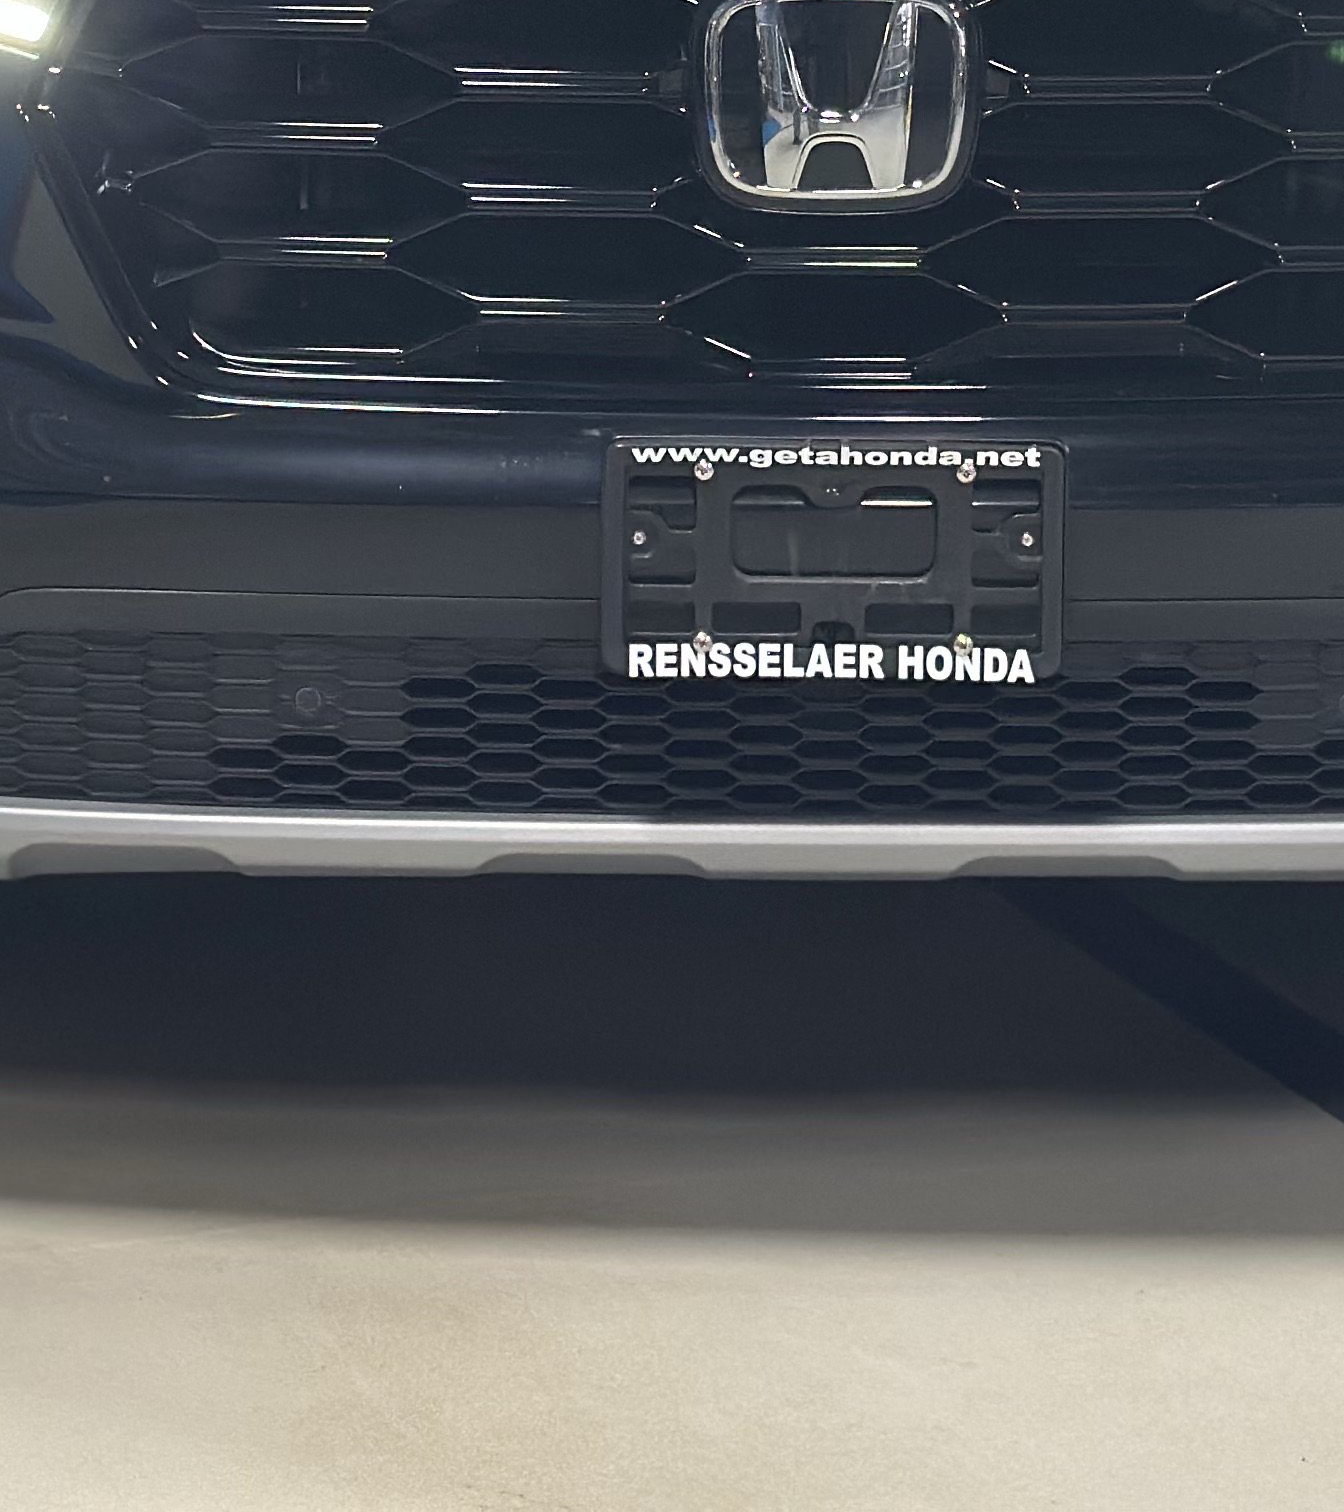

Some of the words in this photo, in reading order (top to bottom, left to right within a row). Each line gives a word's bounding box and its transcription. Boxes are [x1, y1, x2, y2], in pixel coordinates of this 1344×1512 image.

[631, 444, 1041, 468] www.getahonda.net
[628, 643, 885, 679] RENSSELAER
[897, 644, 1036, 684] HONDA
